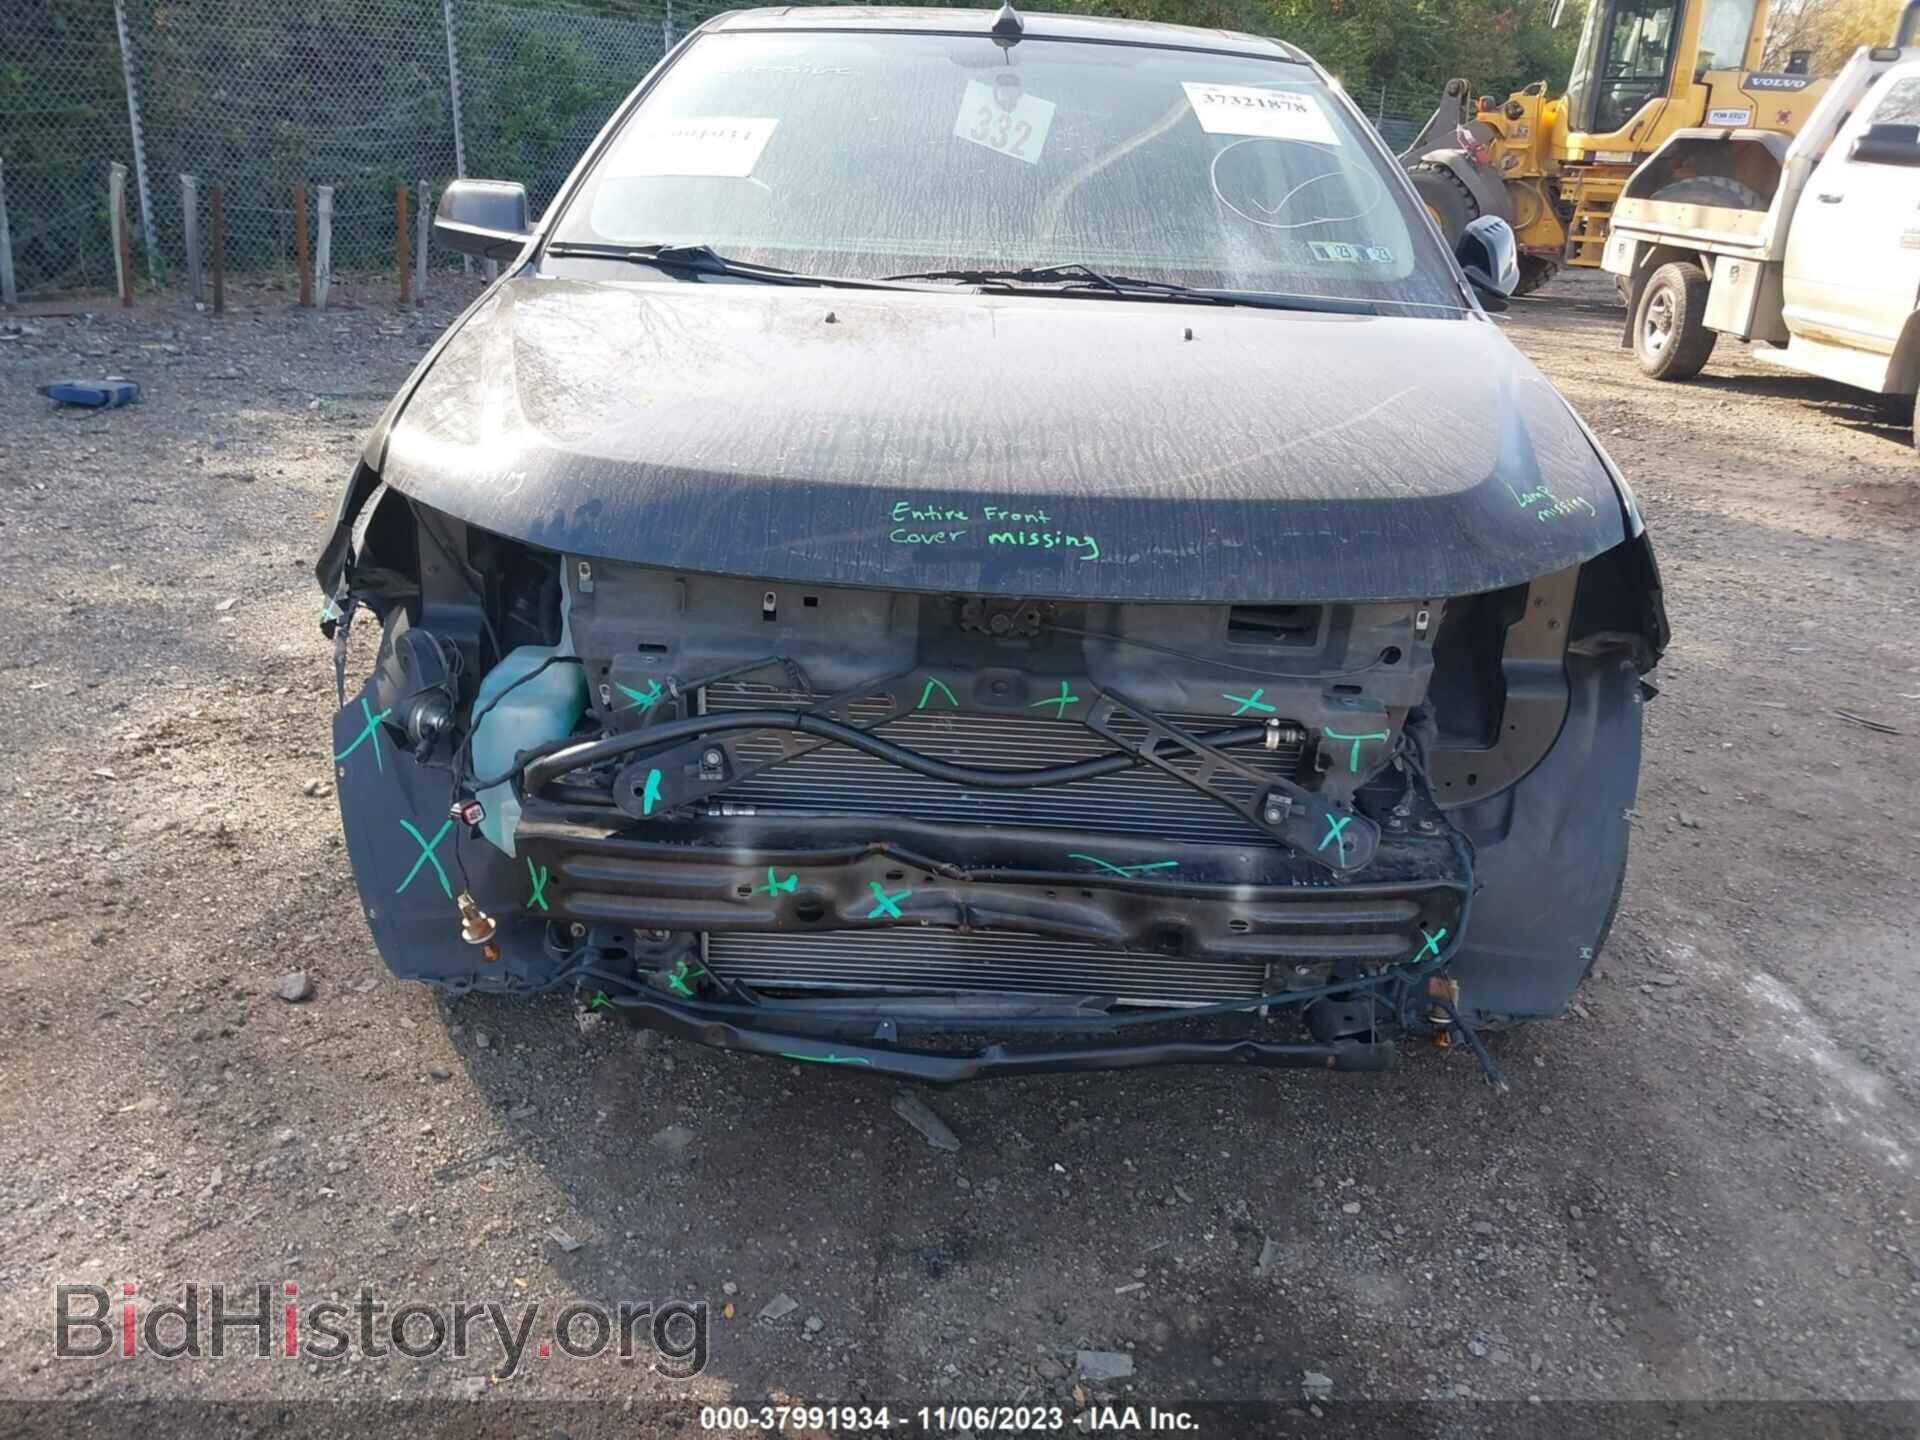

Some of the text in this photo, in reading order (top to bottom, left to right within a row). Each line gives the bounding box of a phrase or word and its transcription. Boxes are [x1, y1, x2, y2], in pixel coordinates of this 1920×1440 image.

[1751, 77, 1807, 88] VOLVO
[1203, 94, 1308, 113] 37321878
[970, 105, 1033, 156] 332
[890, 501, 1052, 524] Entire Front
[889, 529, 1101, 561] Cover missing
